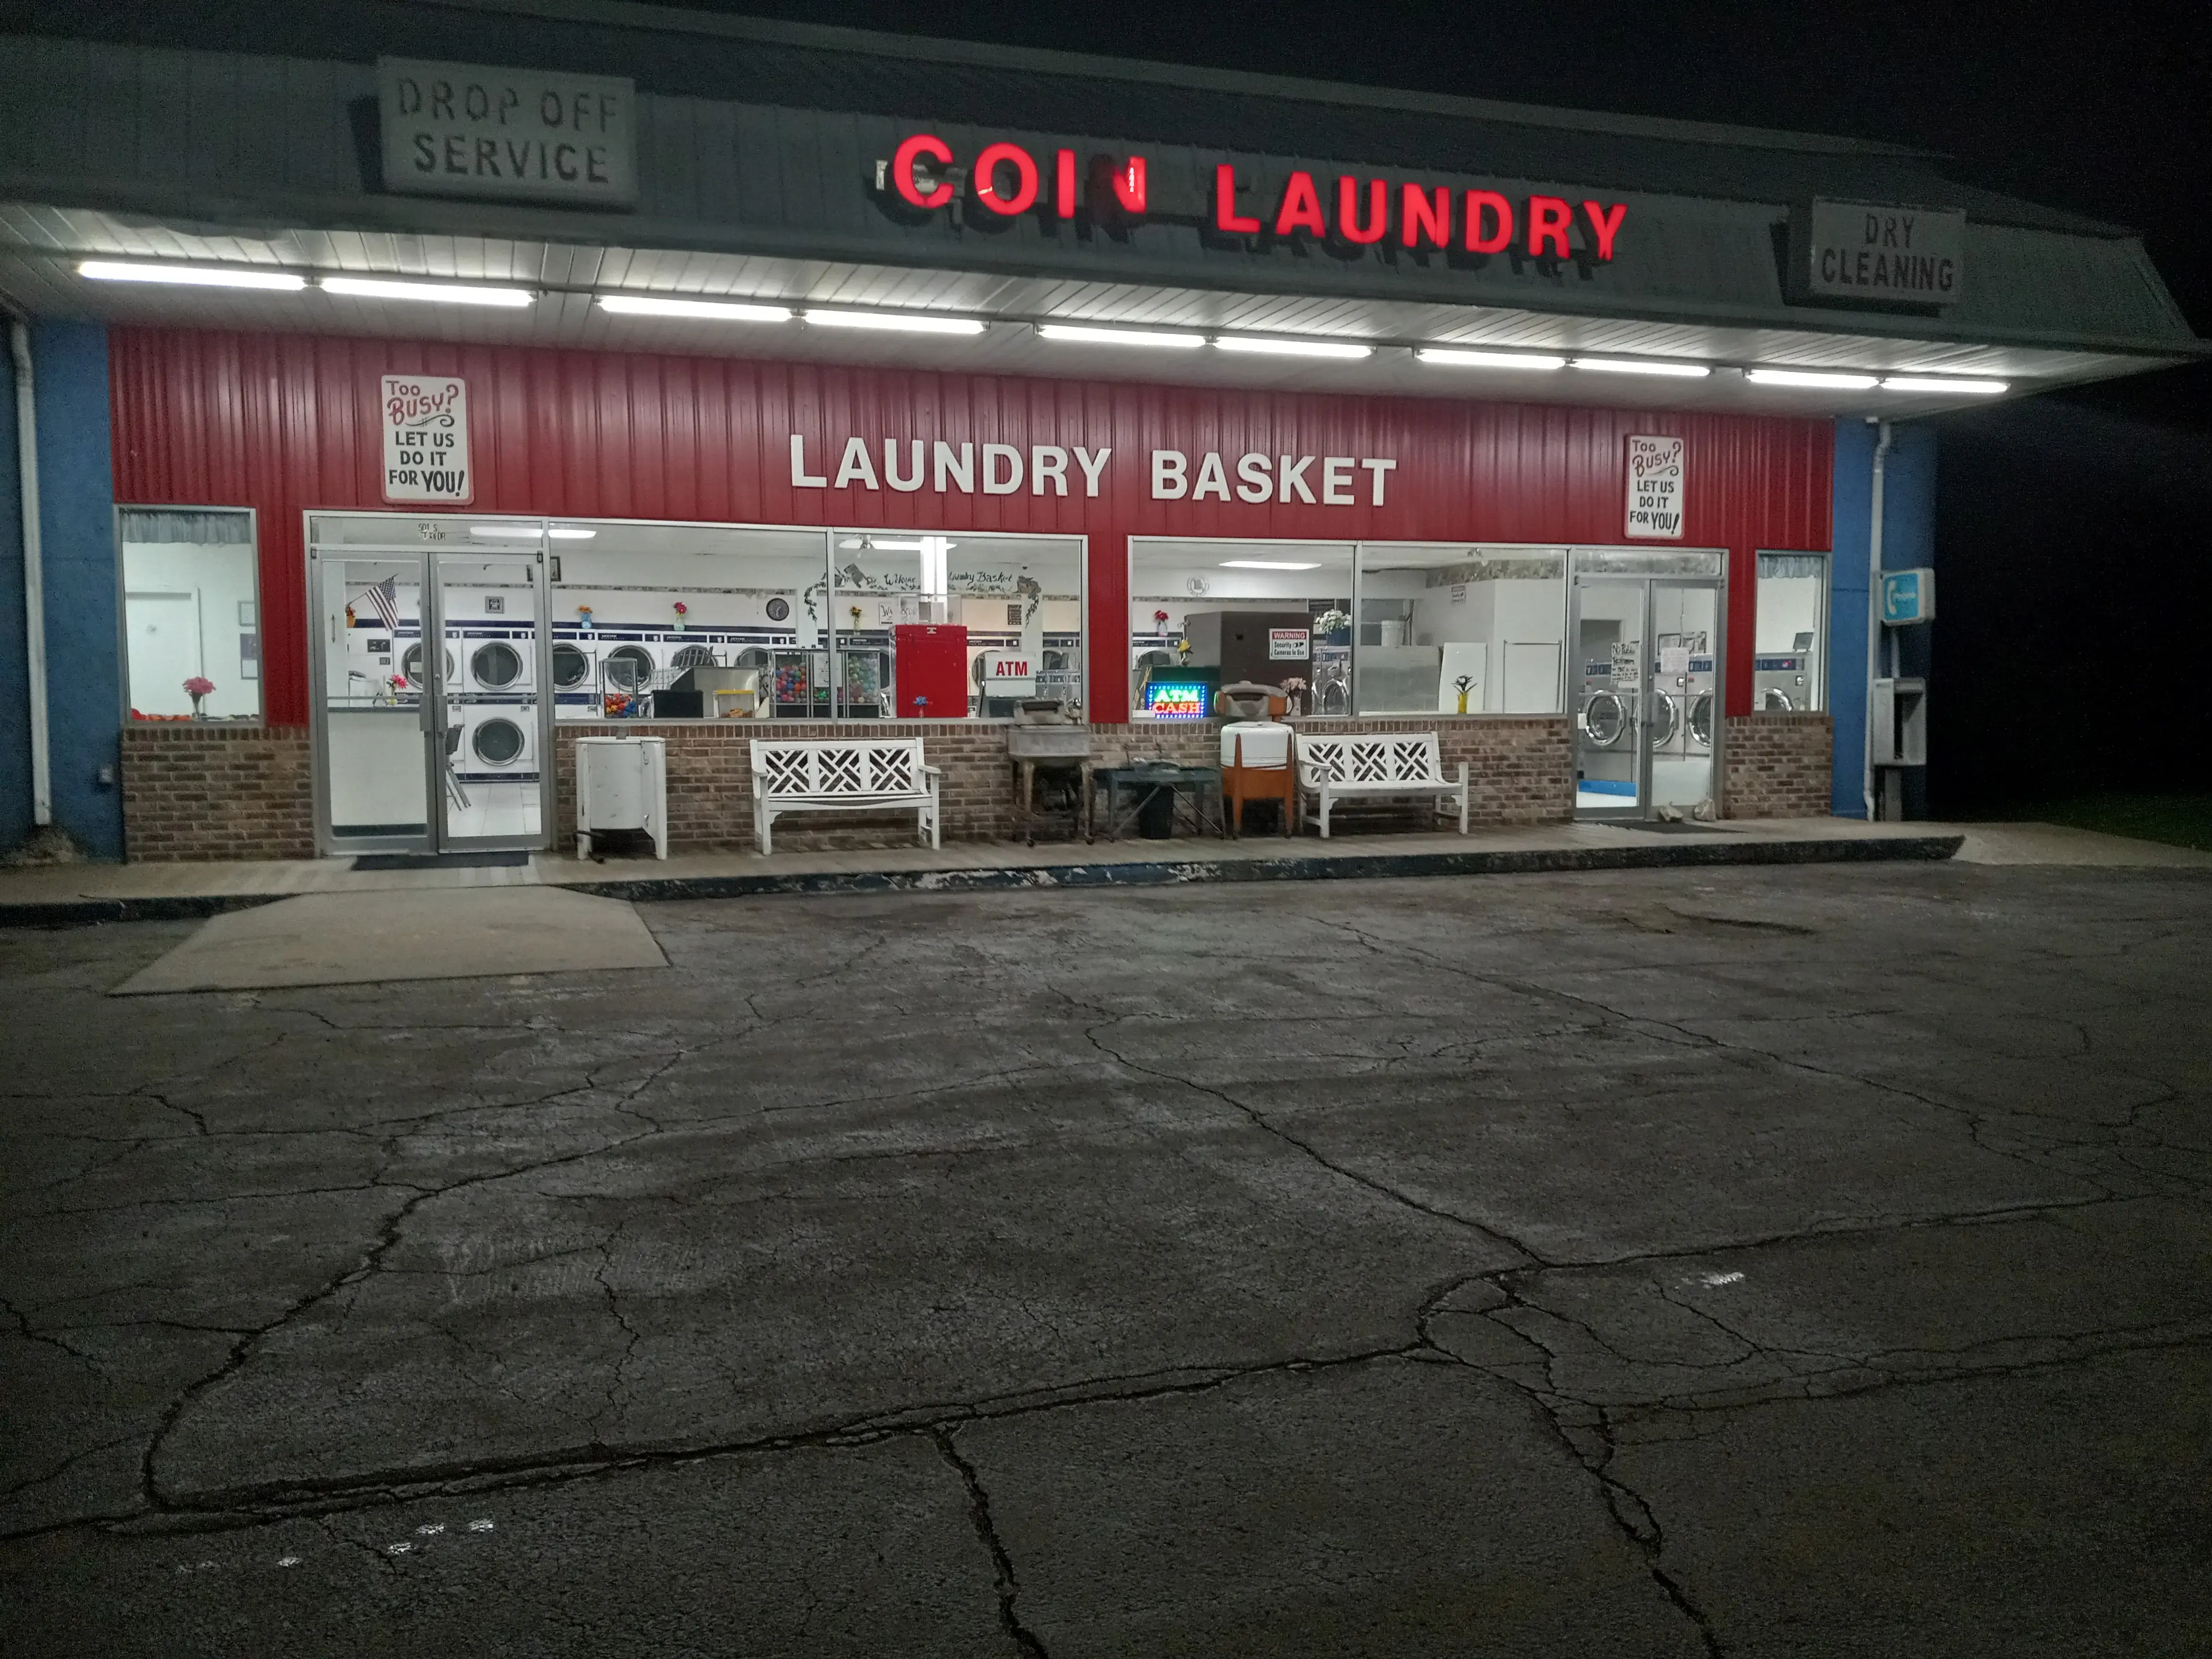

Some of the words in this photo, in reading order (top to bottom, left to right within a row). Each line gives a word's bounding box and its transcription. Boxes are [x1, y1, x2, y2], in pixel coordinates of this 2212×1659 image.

[398, 77, 520, 126] DROP
[540, 89, 617, 134] OFF
[412, 131, 609, 184] SERVICE
[893, 133, 1147, 218] COIN
[1216, 164, 1627, 261] LAUNDRY
[1865, 213, 1915, 249] DRY
[1821, 247, 1954, 291] CLEANING
[395, 431, 428, 446] LET
[433, 432, 455, 447] US
[400, 450, 424, 465] DO
[430, 451, 447, 466] IT
[790, 433, 1112, 498] LAUNDRY
[1151, 449, 1397, 507] BASKET
[389, 469, 419, 486] FOR
[421, 469, 465, 497] YOU!
[1637, 480, 1658, 493] LET
[1660, 481, 1674, 493] US
[1639, 495, 1654, 507] DO
[1658, 496, 1669, 509] IT
[1629, 510, 1649, 524] FOR
[1651, 512, 1680, 535] YOU!
[1274, 641, 1292, 649] Security
[996, 661, 1028, 676] ATM
[1154, 689, 1199, 702] ATM
[1153, 702, 1201, 714] CASH
